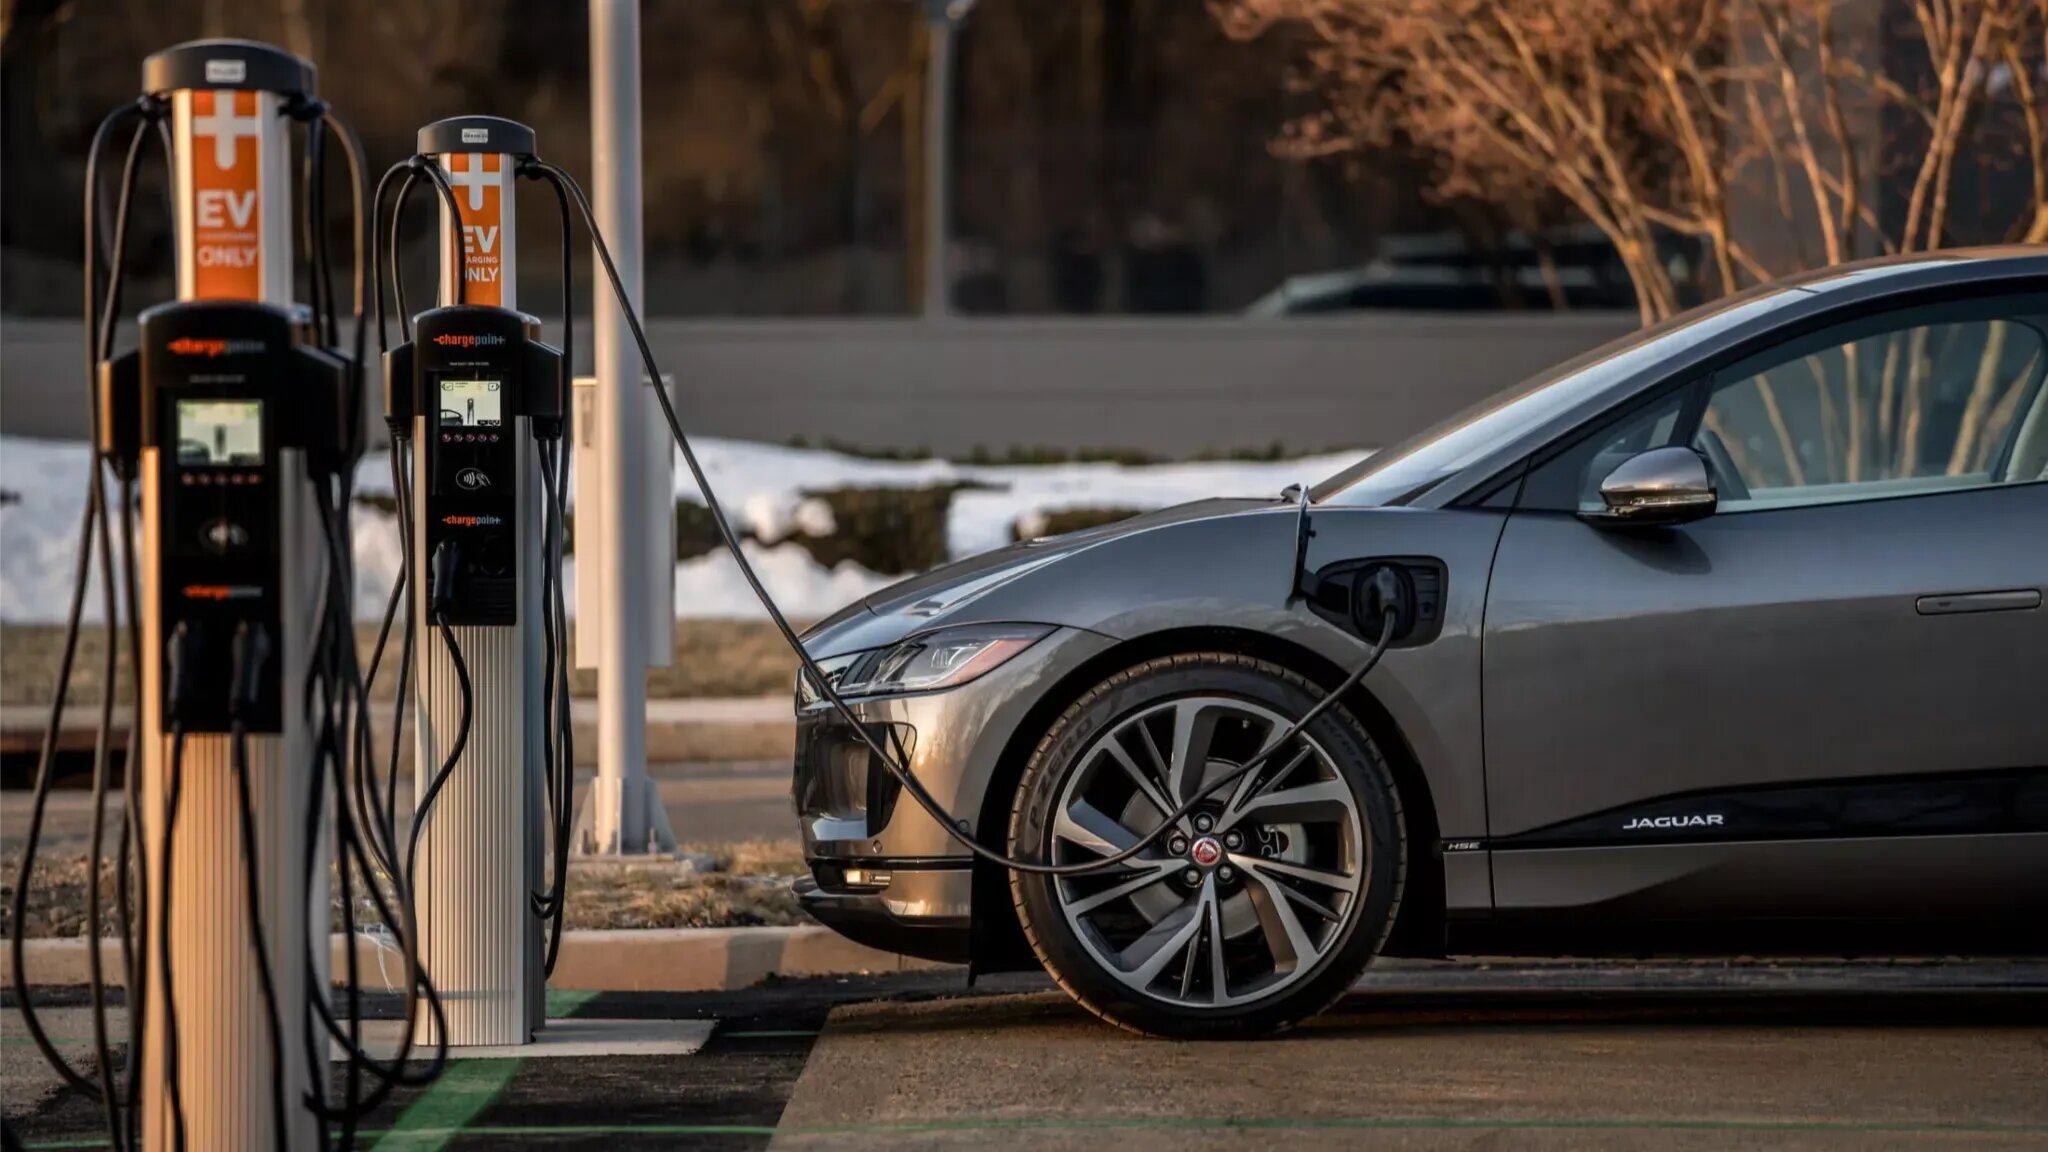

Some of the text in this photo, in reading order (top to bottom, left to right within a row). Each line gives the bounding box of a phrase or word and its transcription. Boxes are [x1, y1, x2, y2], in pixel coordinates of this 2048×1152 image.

[197, 189, 257, 228] EV
[463, 225, 498, 253] EV
[197, 245, 258, 269] ONLY
[466, 256, 498, 265] ARGING
[465, 267, 499, 282] NLY
[1622, 814, 1724, 829] JAGUAR
[1448, 841, 1481, 850] HSE
